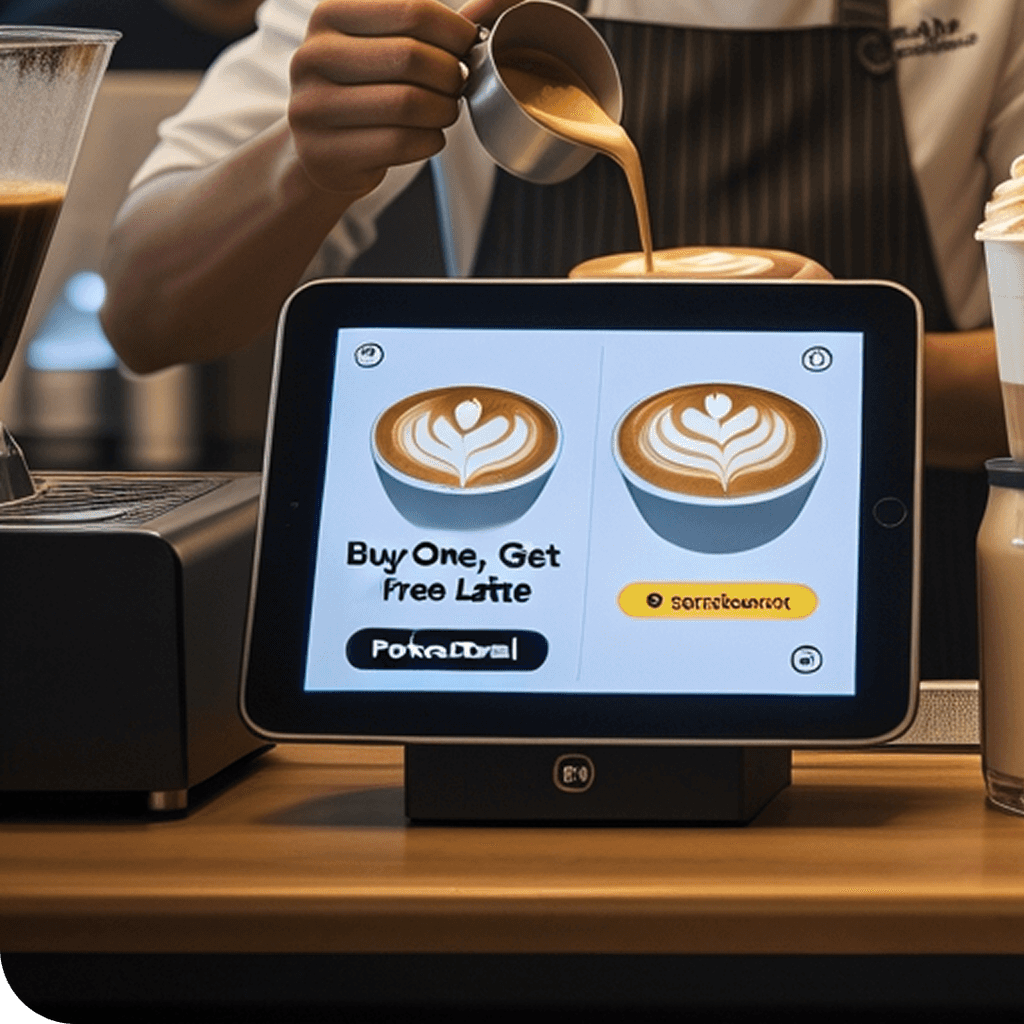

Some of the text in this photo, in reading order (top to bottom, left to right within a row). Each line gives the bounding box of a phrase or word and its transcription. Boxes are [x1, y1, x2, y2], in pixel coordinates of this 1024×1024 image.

[347, 541, 561, 574] Buy One, Get
[383, 577, 446, 602] Free
